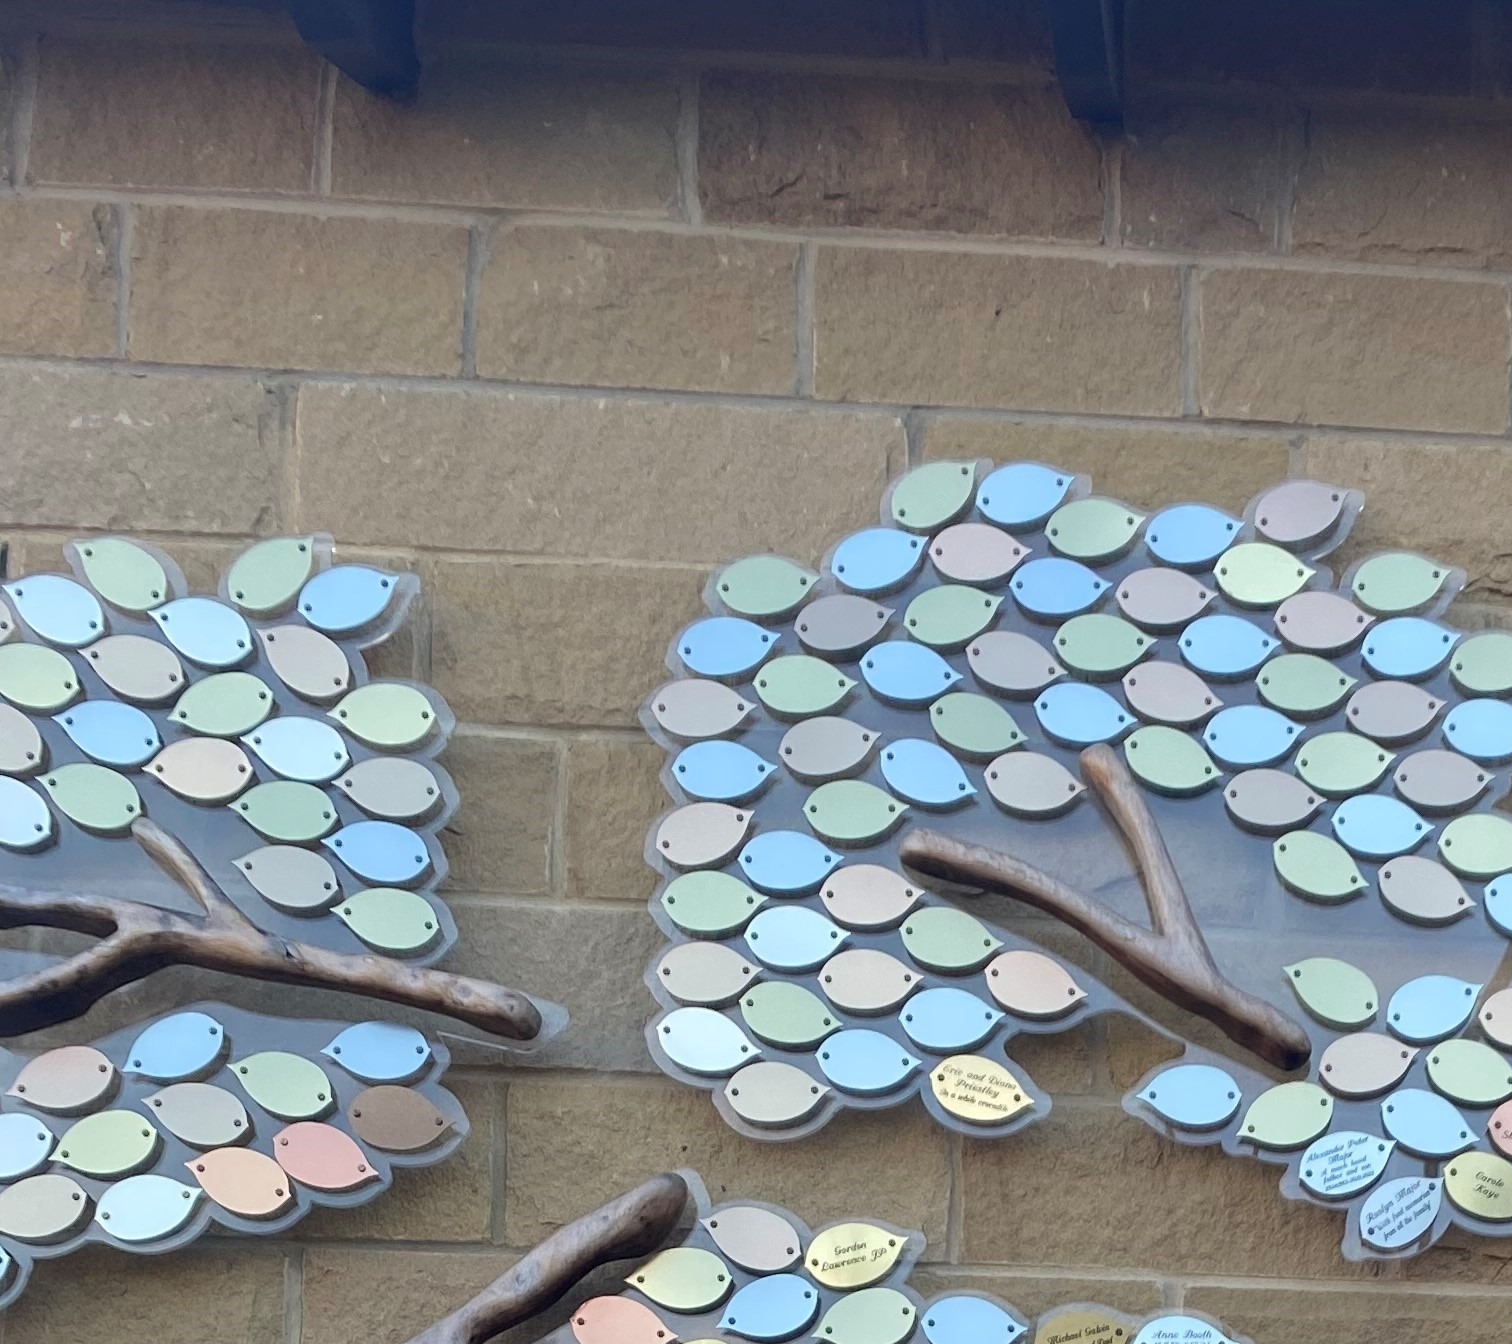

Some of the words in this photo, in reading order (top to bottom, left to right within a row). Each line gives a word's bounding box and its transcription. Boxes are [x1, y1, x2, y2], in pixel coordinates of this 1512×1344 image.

[967, 1072, 987, 1081] and
[1475, 1171, 1505, 1188] Carole
[1473, 1184, 1500, 1199] Kaye
[834, 1241, 867, 1256] Gordon
[1151, 1330, 1179, 1339] Anne
